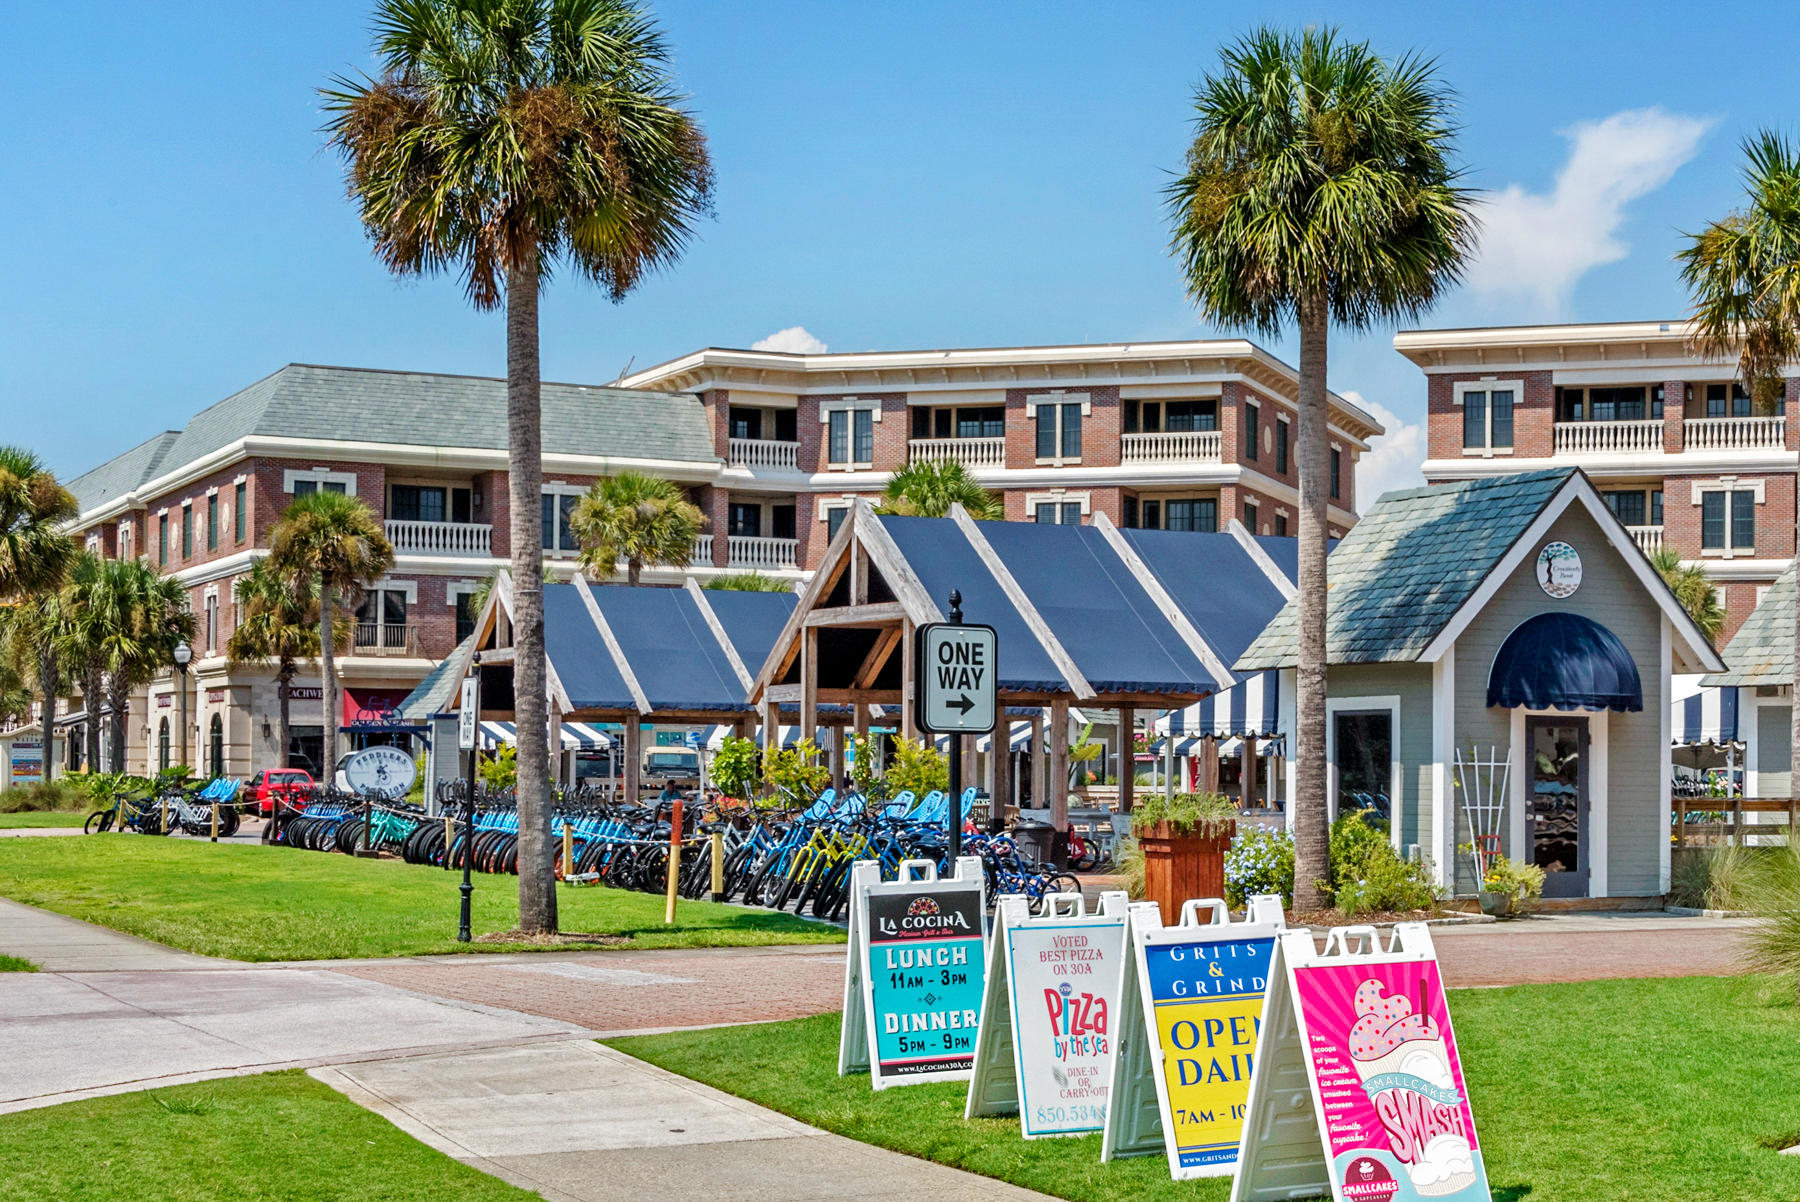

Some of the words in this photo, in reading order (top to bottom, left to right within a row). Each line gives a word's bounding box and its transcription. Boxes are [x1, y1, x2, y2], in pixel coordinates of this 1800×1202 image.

[938, 641, 984, 665] ONE
[937, 666, 985, 690] WAY
[880, 917, 898, 935] LA
[902, 911, 971, 929] COCINA
[1052, 935, 1088, 948] VOTED
[886, 946, 968, 970] LUNCH
[1040, 949, 1067, 962] BEST
[1070, 948, 1104, 961] PIZZA
[1170, 943, 1256, 961] GRITS
[1053, 964, 1068, 975] ON
[1070, 962, 1092, 975] 30A
[1208, 961, 1224, 977] &
[1172, 977, 1266, 995] GRIND
[1044, 982, 1108, 1036] Pizza
[884, 1009, 979, 1034] DINNER
[1054, 1037, 1068, 1062] by
[1069, 1036, 1090, 1056] the
[1324, 1057, 1339, 1065] your
[1067, 1066, 1099, 1077] DINE-IN
[1318, 1066, 1350, 1077] favorite
[1077, 1077, 1091, 1088] OR
[1321, 1079, 1332, 1087] ice
[1332, 1078, 1358, 1086] cream
[1366, 1076, 1457, 1102] SMALLCAKES
[1323, 1089, 1351, 1098] smashed
[1325, 1101, 1354, 1109] between
[1177, 1109, 1215, 1125] 7AM
[1327, 1114, 1342, 1122] your
[1330, 1121, 1362, 1134] favorite
[1375, 1088, 1467, 1166] SMASH
[1343, 1181, 1398, 1195] SMALLCAKES
